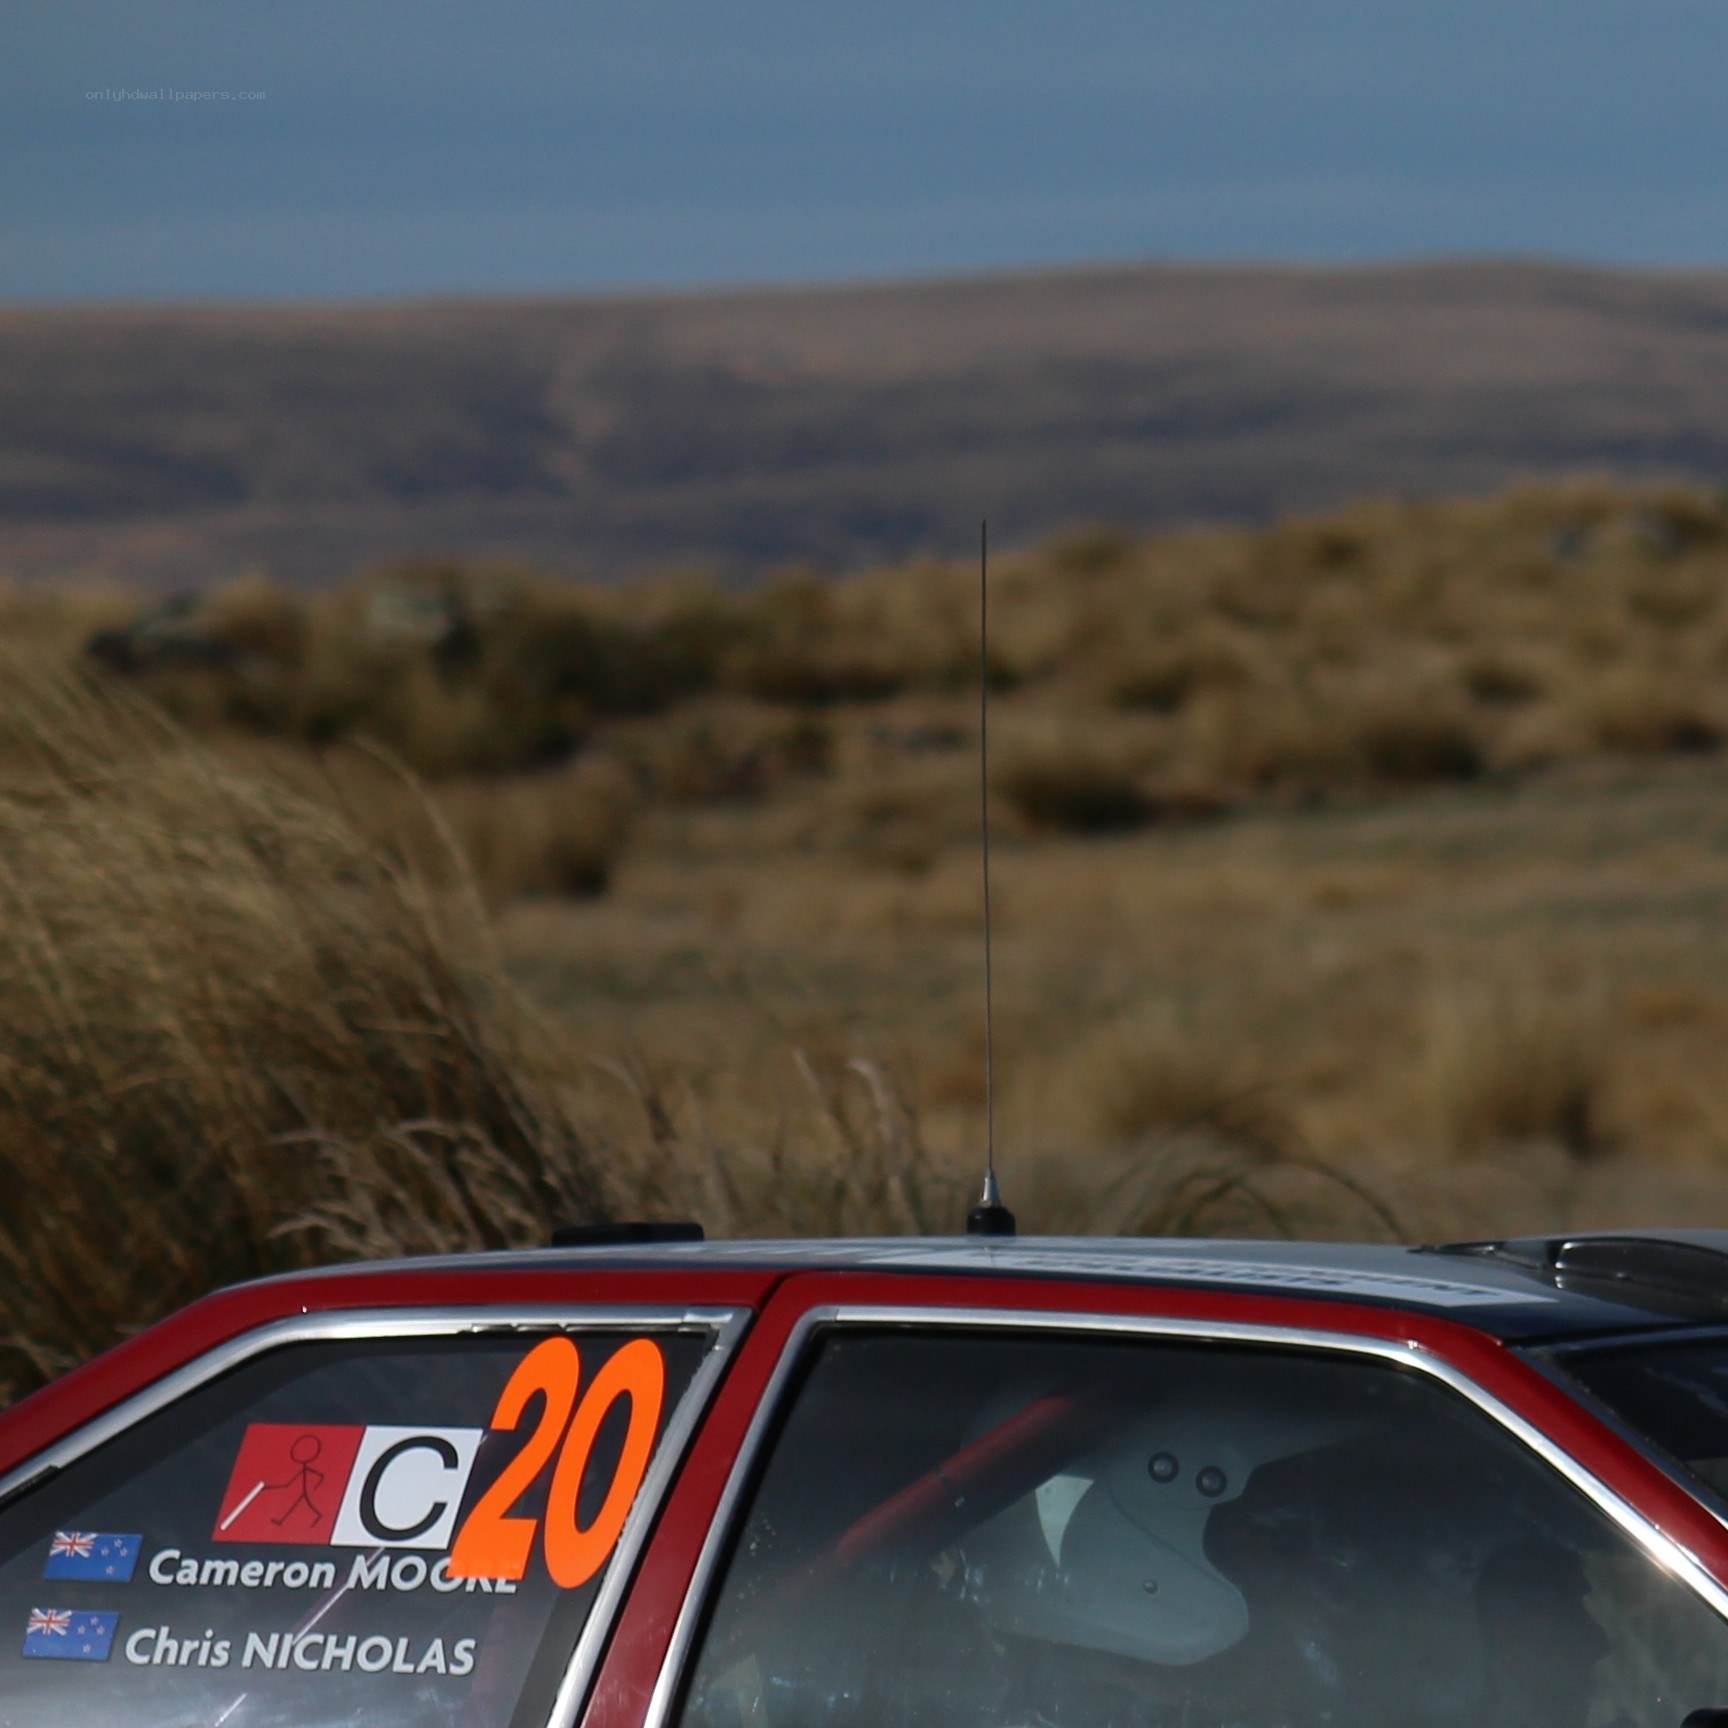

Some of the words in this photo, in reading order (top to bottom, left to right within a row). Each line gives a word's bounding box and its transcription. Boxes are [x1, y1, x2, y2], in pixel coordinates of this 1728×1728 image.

[359, 1436, 459, 1542] C
[446, 1337, 664, 1589] 20
[149, 1549, 337, 1589] Cameron
[126, 1626, 230, 1668] Chris
[241, 1632, 476, 1676] NICHOLAS
